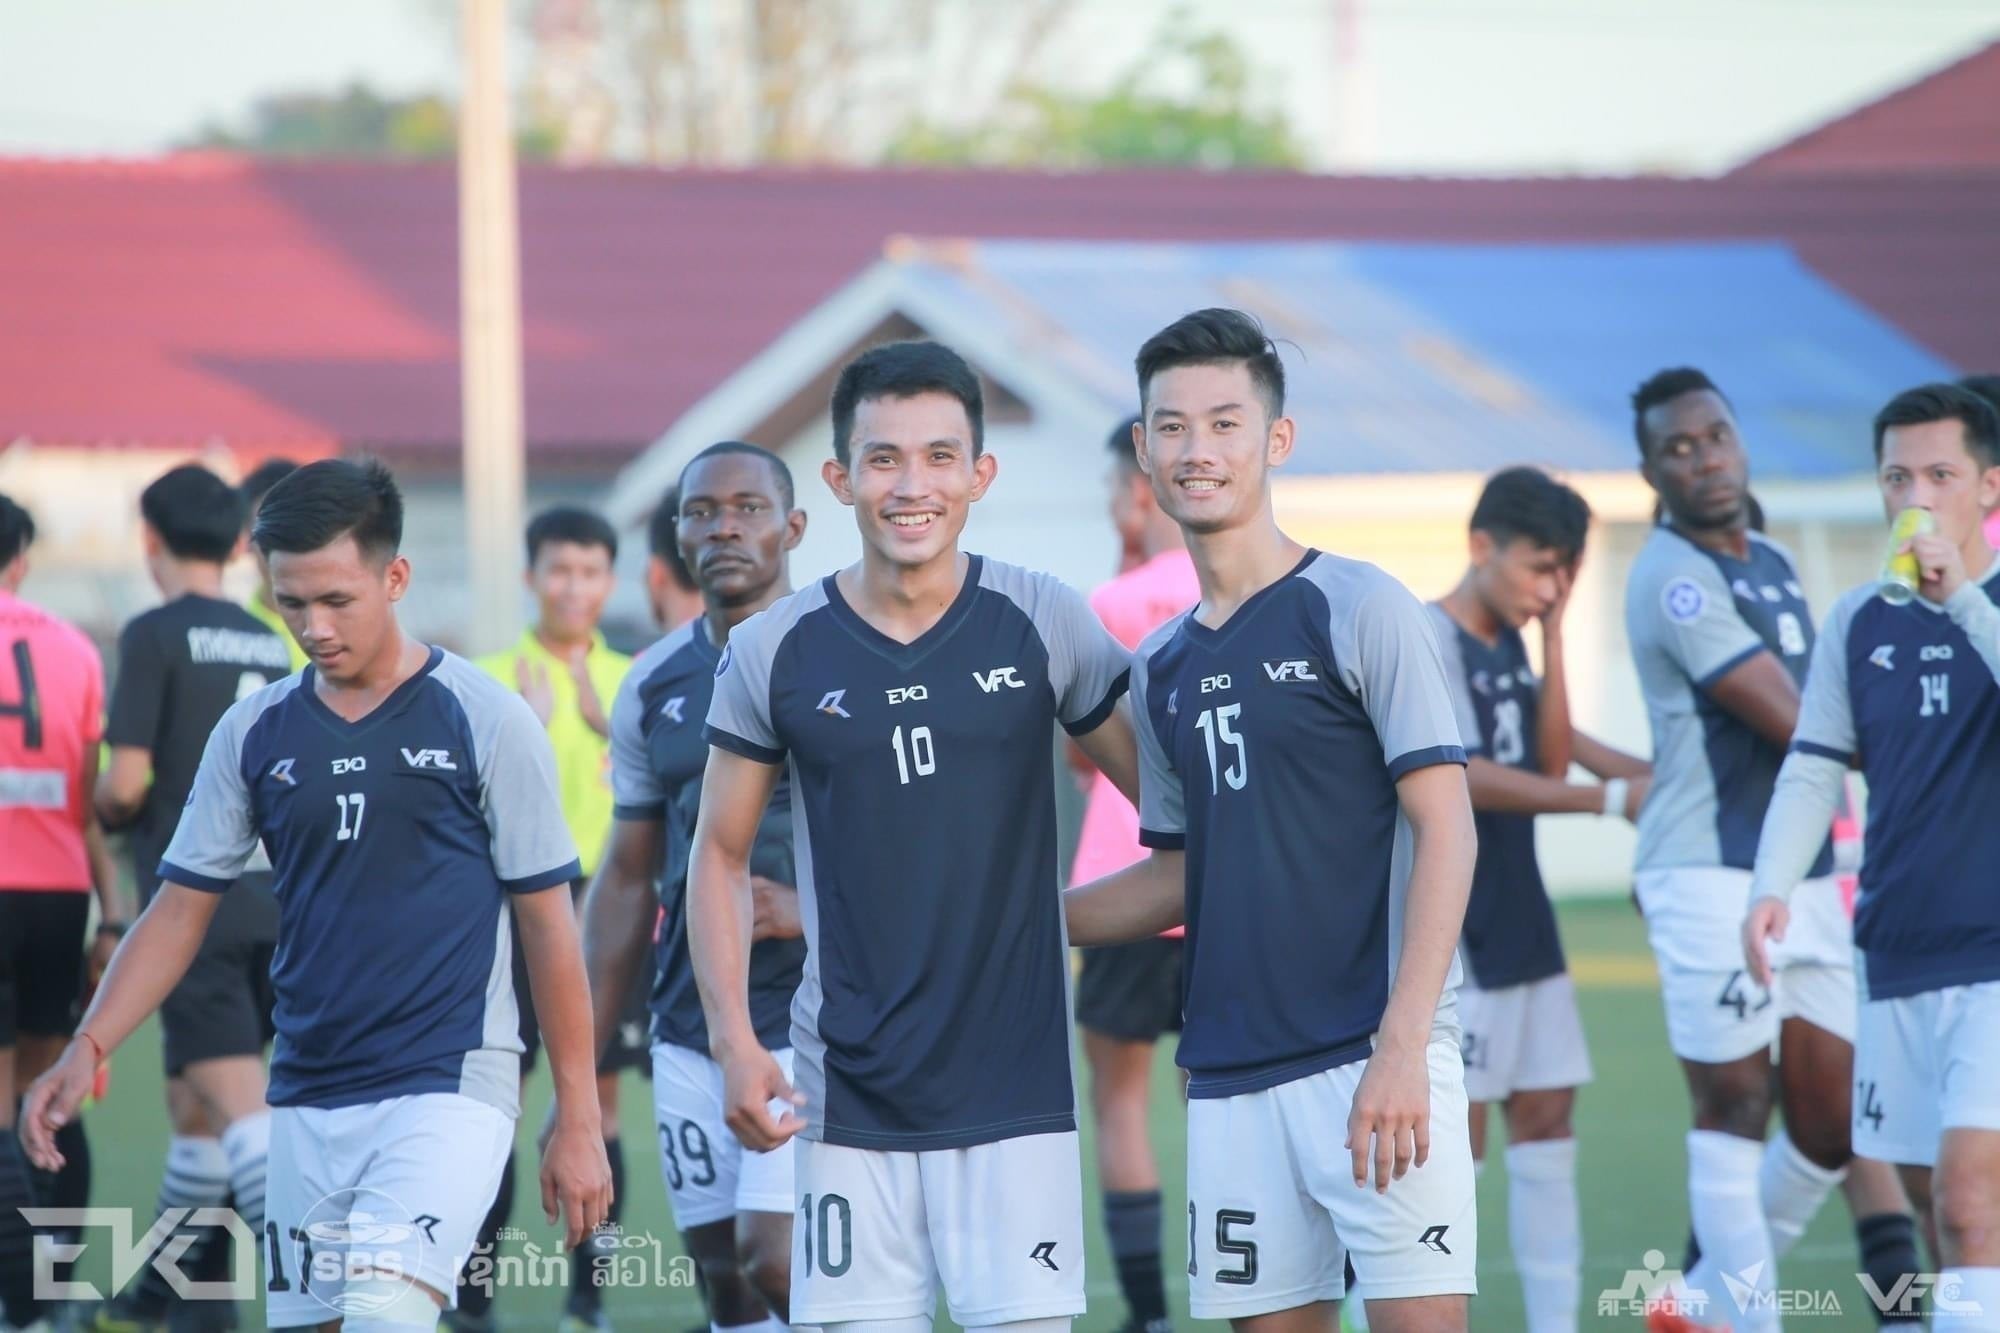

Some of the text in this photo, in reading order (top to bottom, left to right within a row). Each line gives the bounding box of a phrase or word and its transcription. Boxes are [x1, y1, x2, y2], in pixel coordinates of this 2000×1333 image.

[972, 666, 1026, 693] VFC
[1263, 660, 1318, 681] VFC
[1920, 673, 1949, 716] 14
[400, 747, 457, 770] VFC
[892, 725, 936, 784] 10
[1195, 702, 1247, 795] 15
[336, 792, 365, 840] 17
[659, 1119, 716, 1190] 39
[267, 1221, 312, 1294] 17
[800, 1193, 852, 1278] 10
[1188, 1200, 1258, 1285] 15
